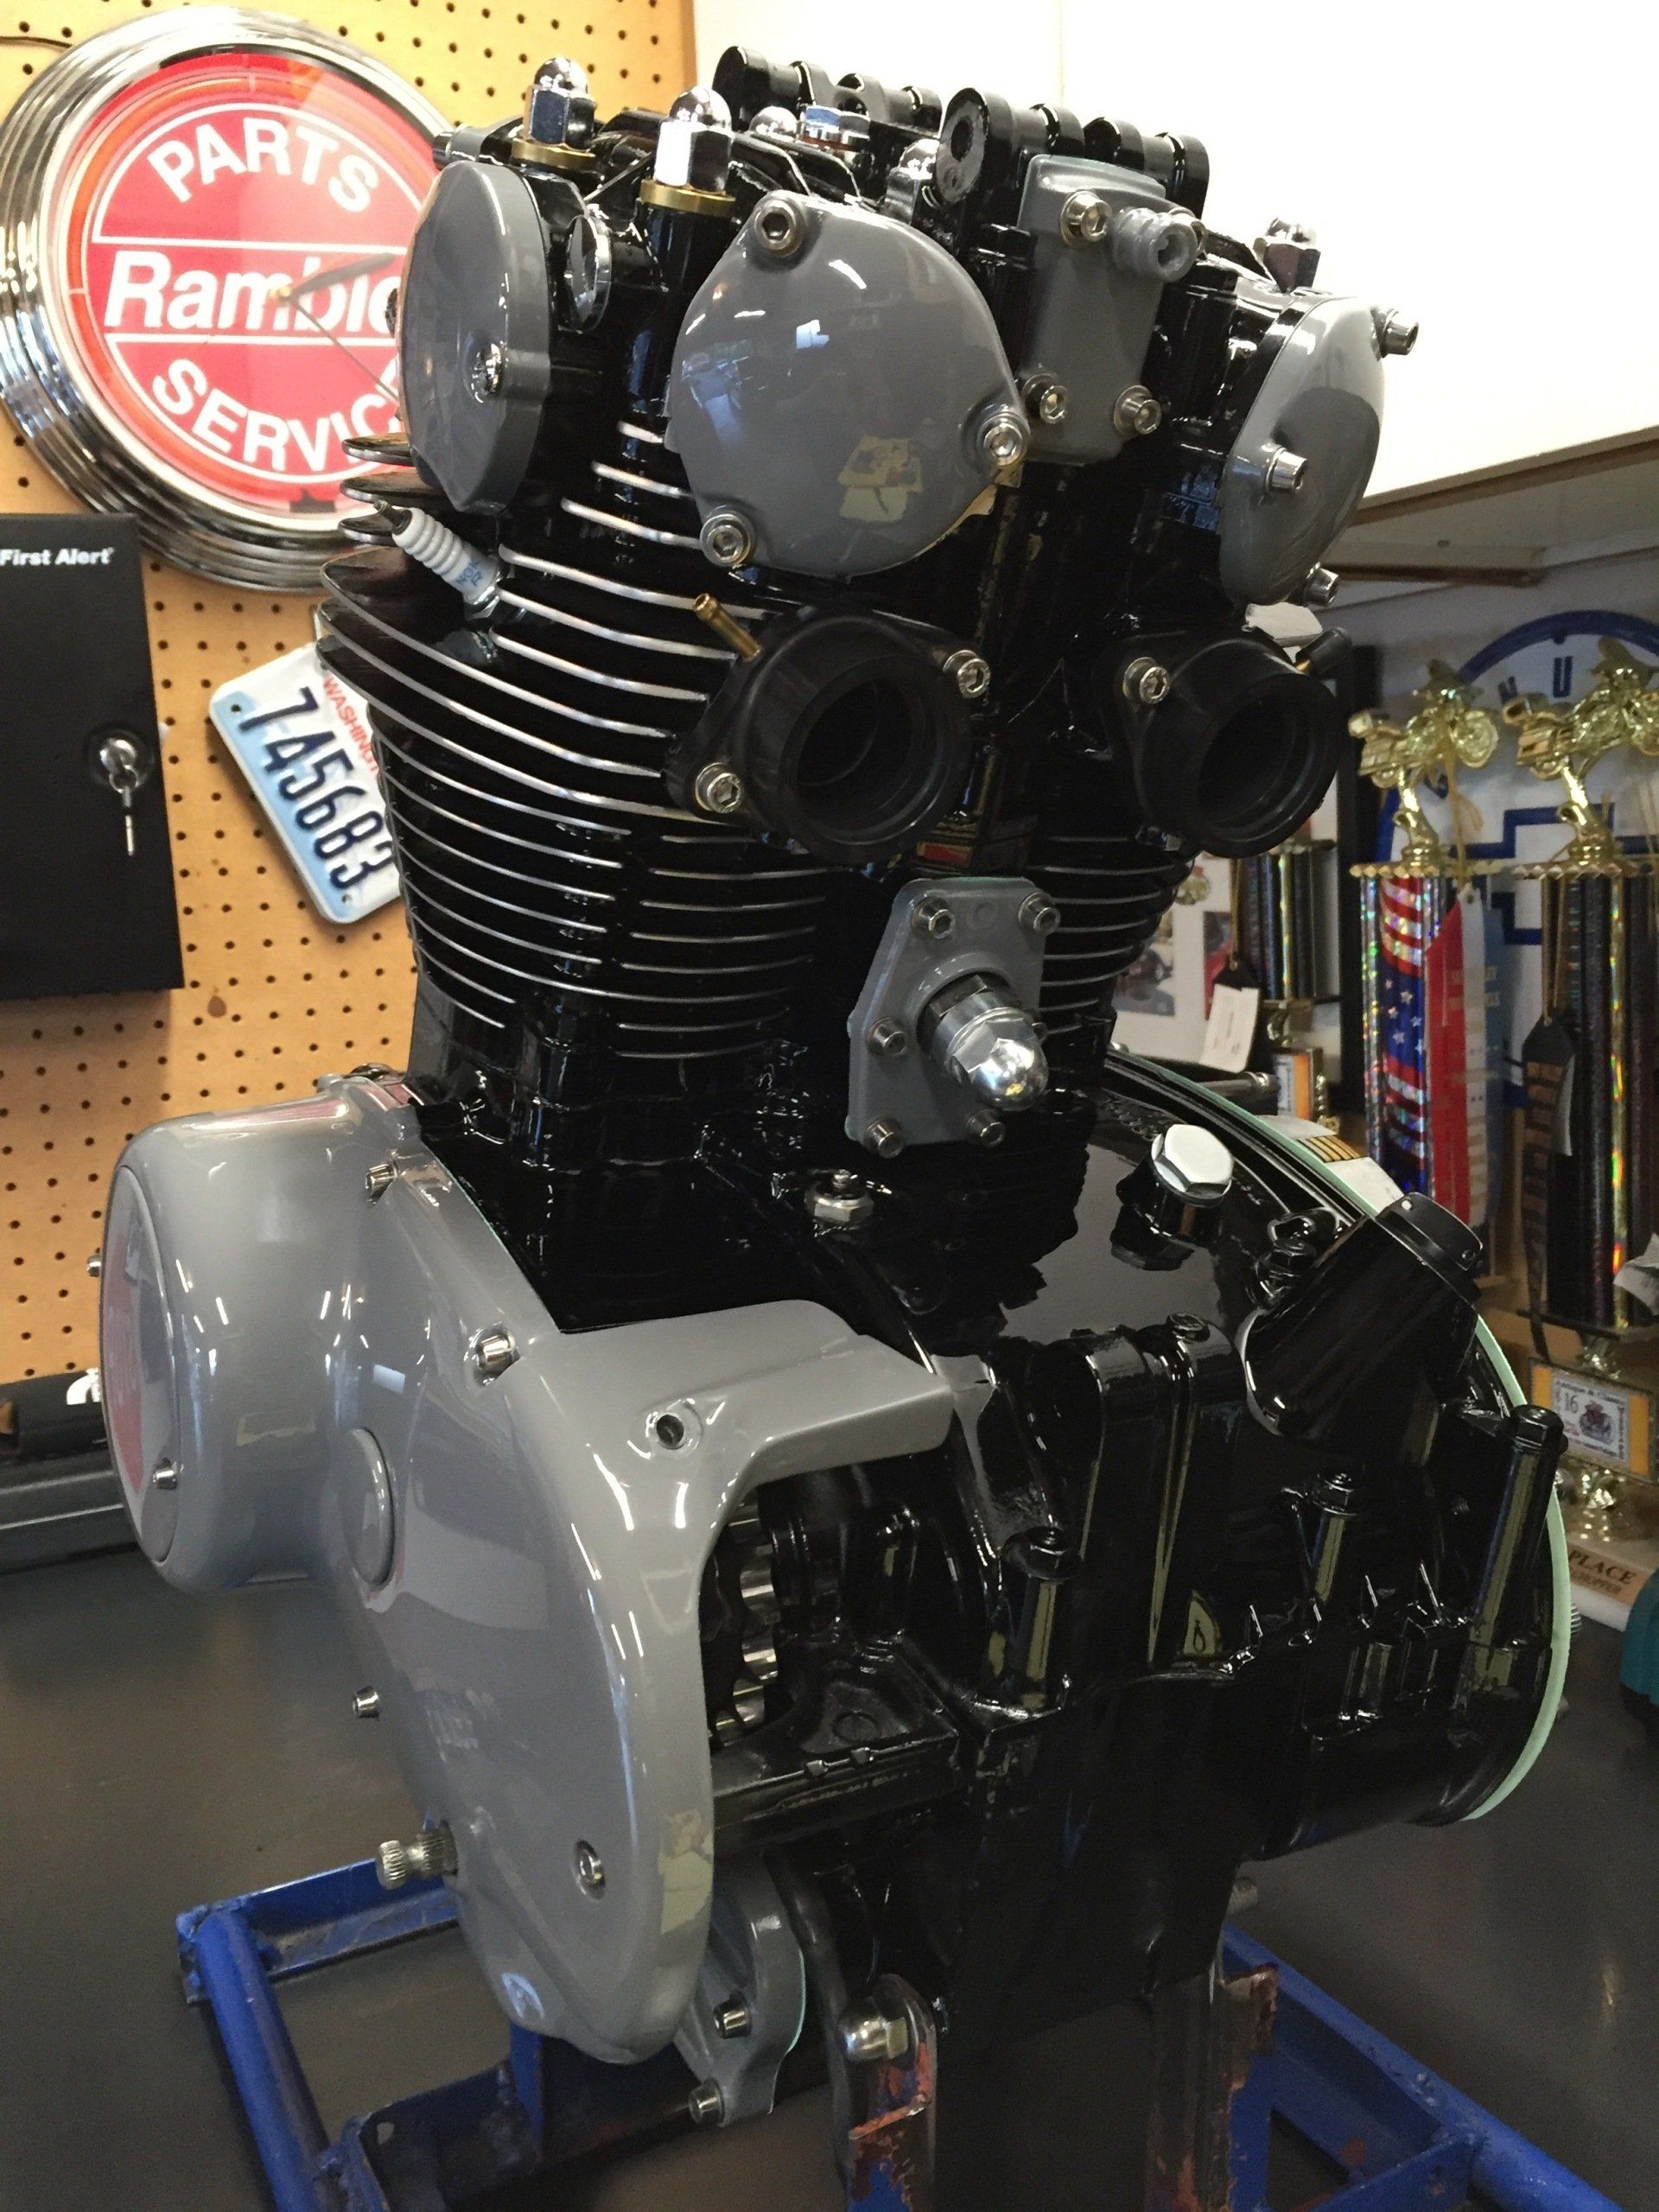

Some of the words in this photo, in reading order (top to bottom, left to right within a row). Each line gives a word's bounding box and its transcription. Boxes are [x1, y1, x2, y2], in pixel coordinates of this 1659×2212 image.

[149, 118, 379, 212] PARTS
[0, 549, 51, 566] First
[54, 548, 111, 565] Alert
[238, 686, 394, 890] 7456683
